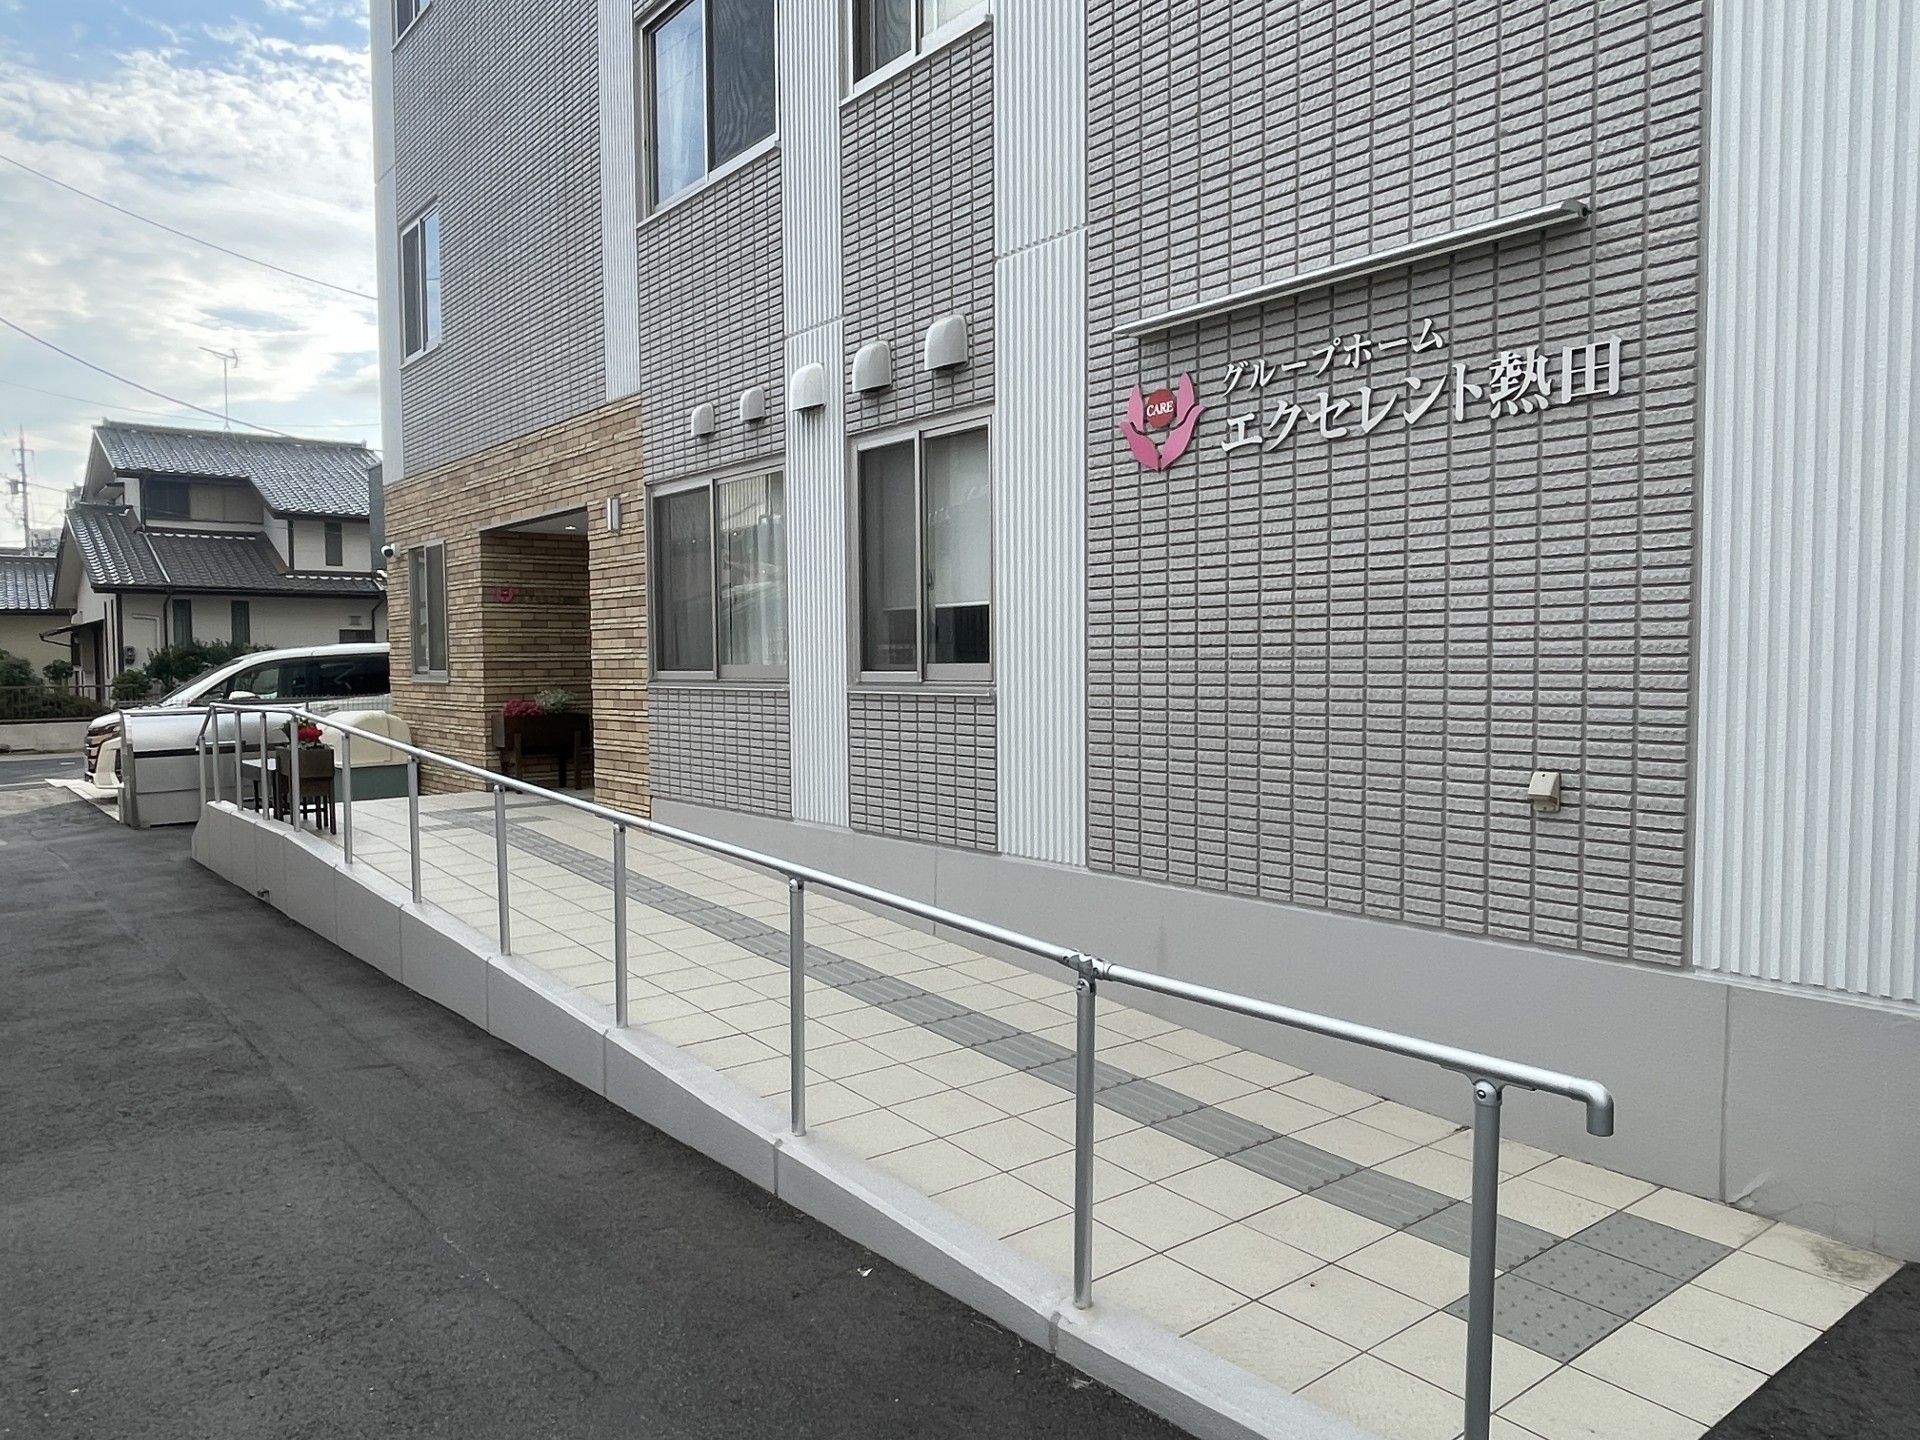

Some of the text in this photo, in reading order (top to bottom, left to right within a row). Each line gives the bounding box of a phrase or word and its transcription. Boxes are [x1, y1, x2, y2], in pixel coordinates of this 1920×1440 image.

[1221, 335, 1622, 452] エクセレント熱田
[1222, 318, 1444, 398] グループホーム
[1146, 400, 1174, 417] CARE
